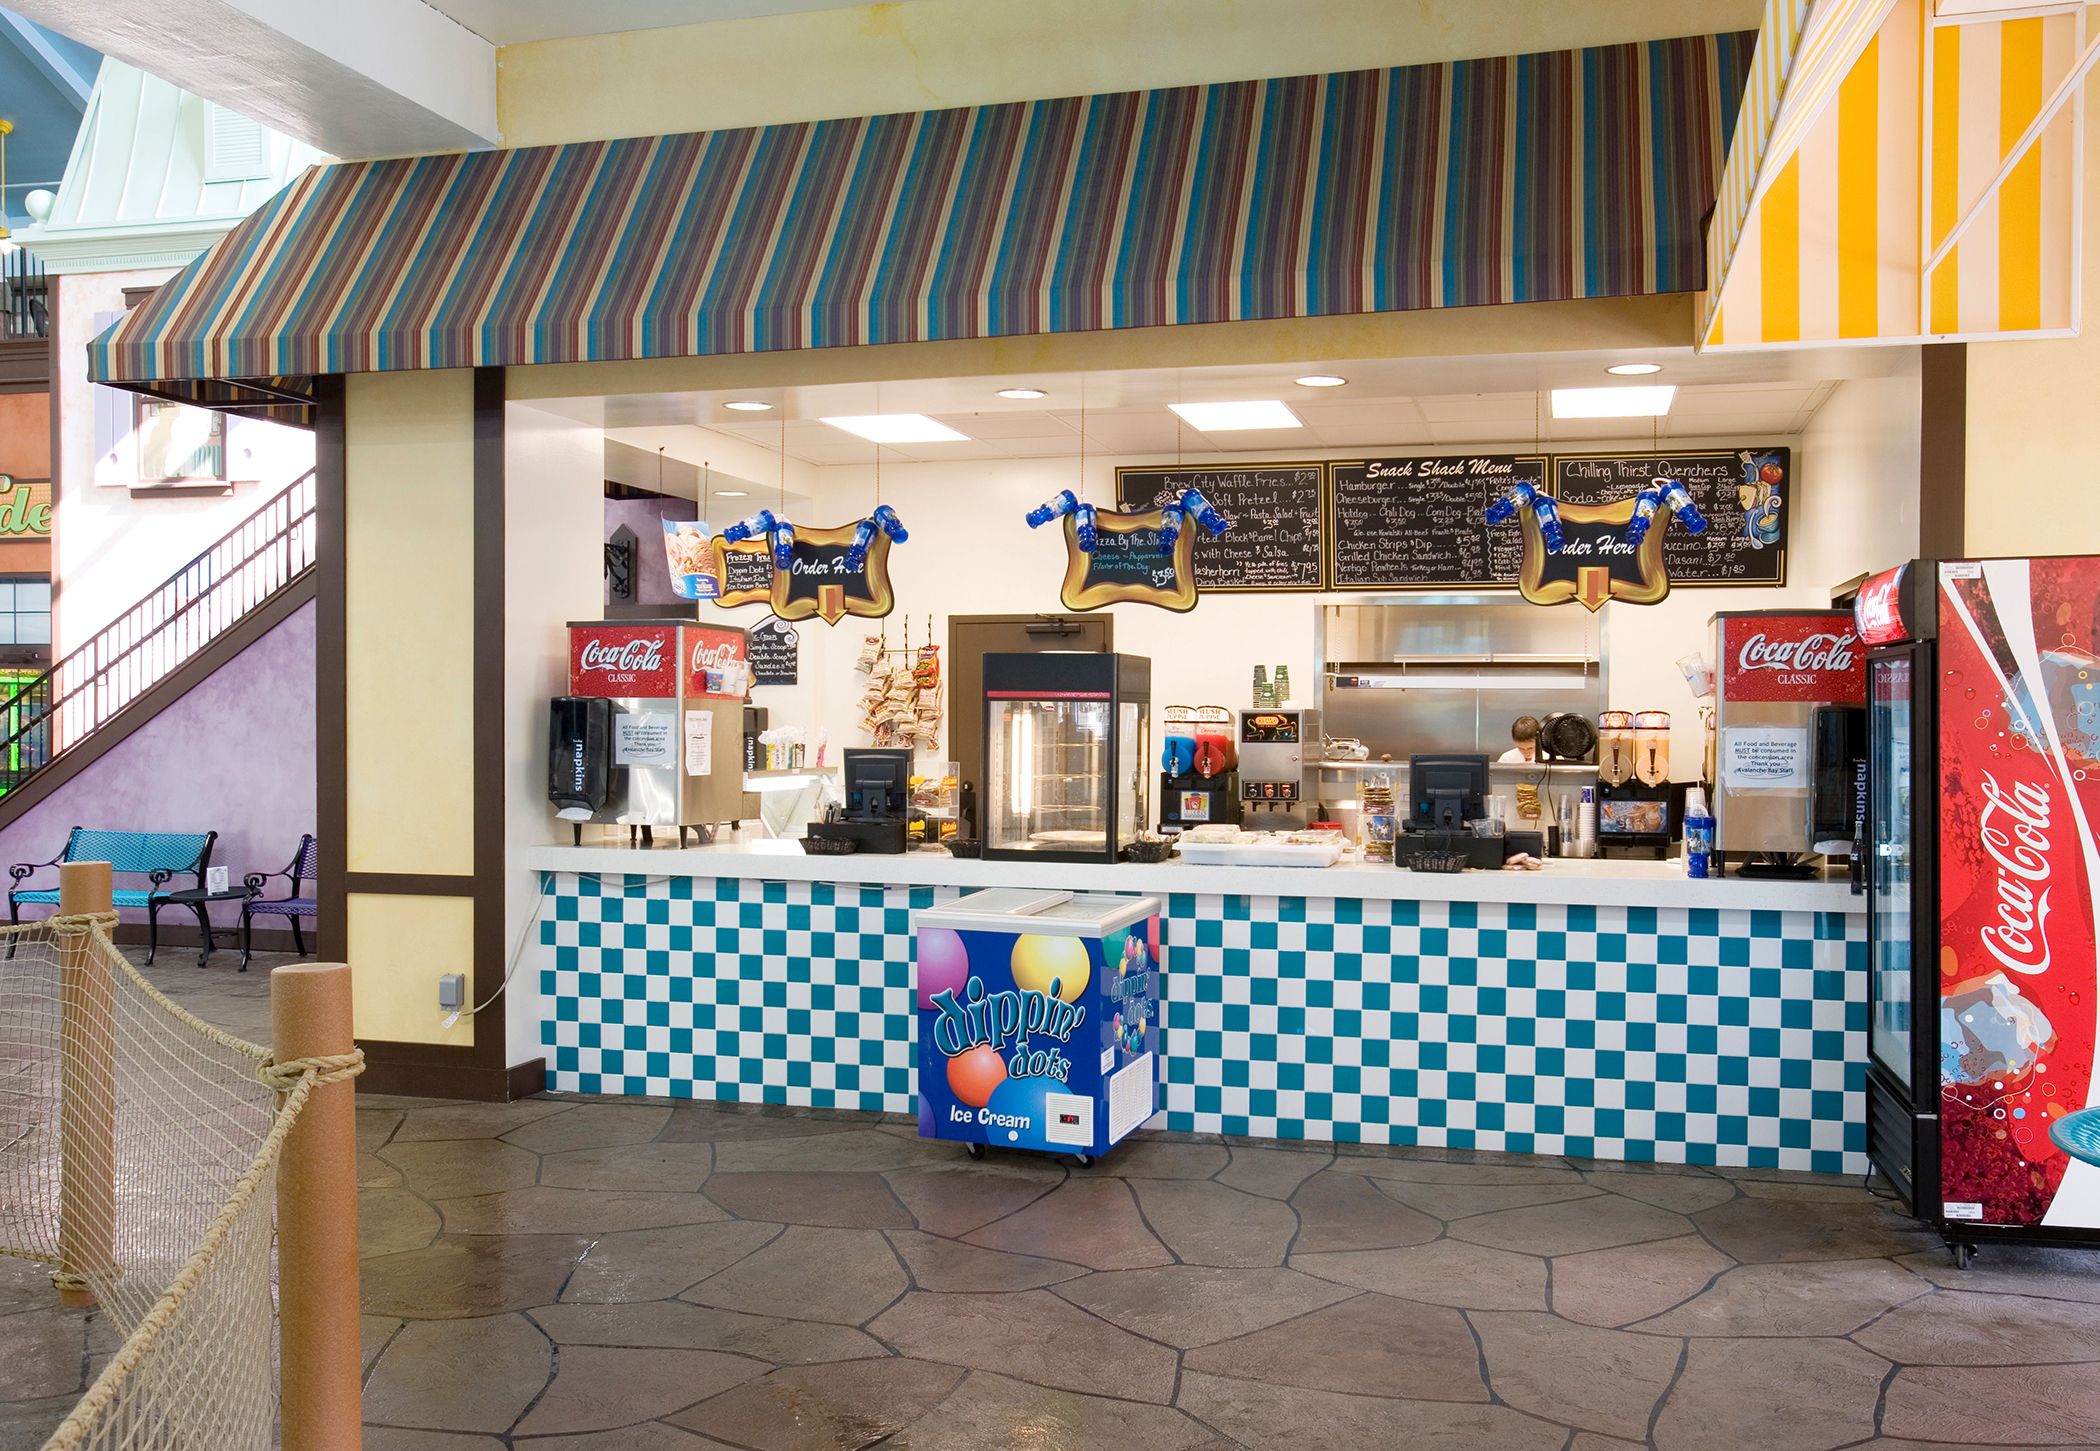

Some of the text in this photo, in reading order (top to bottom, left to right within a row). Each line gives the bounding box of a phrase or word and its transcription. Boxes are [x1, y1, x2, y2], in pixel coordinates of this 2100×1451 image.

[1366, 459, 1512, 478] Snack Shack Menu
[1566, 460, 1729, 482] Chilling Thirst Quenchers
[1164, 476, 1191, 490] Brew
[1193, 475, 1215, 493] City
[1217, 473, 1255, 488] Waffle
[1340, 479, 1396, 494] Hamburger
[1212, 491, 1233, 506] Soft
[1563, 491, 1598, 503] Soda
[1250, 509, 1270, 519] Pasta
[1274, 509, 1293, 519] Salad
[1399, 506, 1416, 519] Dog
[1445, 505, 1461, 519] Dog
[1095, 532, 1145, 551] izza By The
[1197, 533, 1218, 544] rted
[1337, 540, 1376, 550] Chicken
[1378, 538, 1408, 551] Strips
[1548, 535, 1635, 556] rder Here
[726, 552, 753, 564] Frozen
[1201, 548, 1221, 559] with
[1224, 548, 1253, 559] Cheese
[1337, 551, 1370, 561] Grilled
[1373, 551, 1409, 561] Chicken
[792, 557, 829, 575] Order
[832, 556, 864, 574] He
[608, 673, 637, 683] CLASSIC
[1777, 673, 1817, 685] CLASSIC
[573, 743, 585, 791] napkins
[1854, 763, 1867, 821] napkins
[1009, 1044, 1071, 1083] dots
[951, 1104, 1030, 1129] Ice Cream
